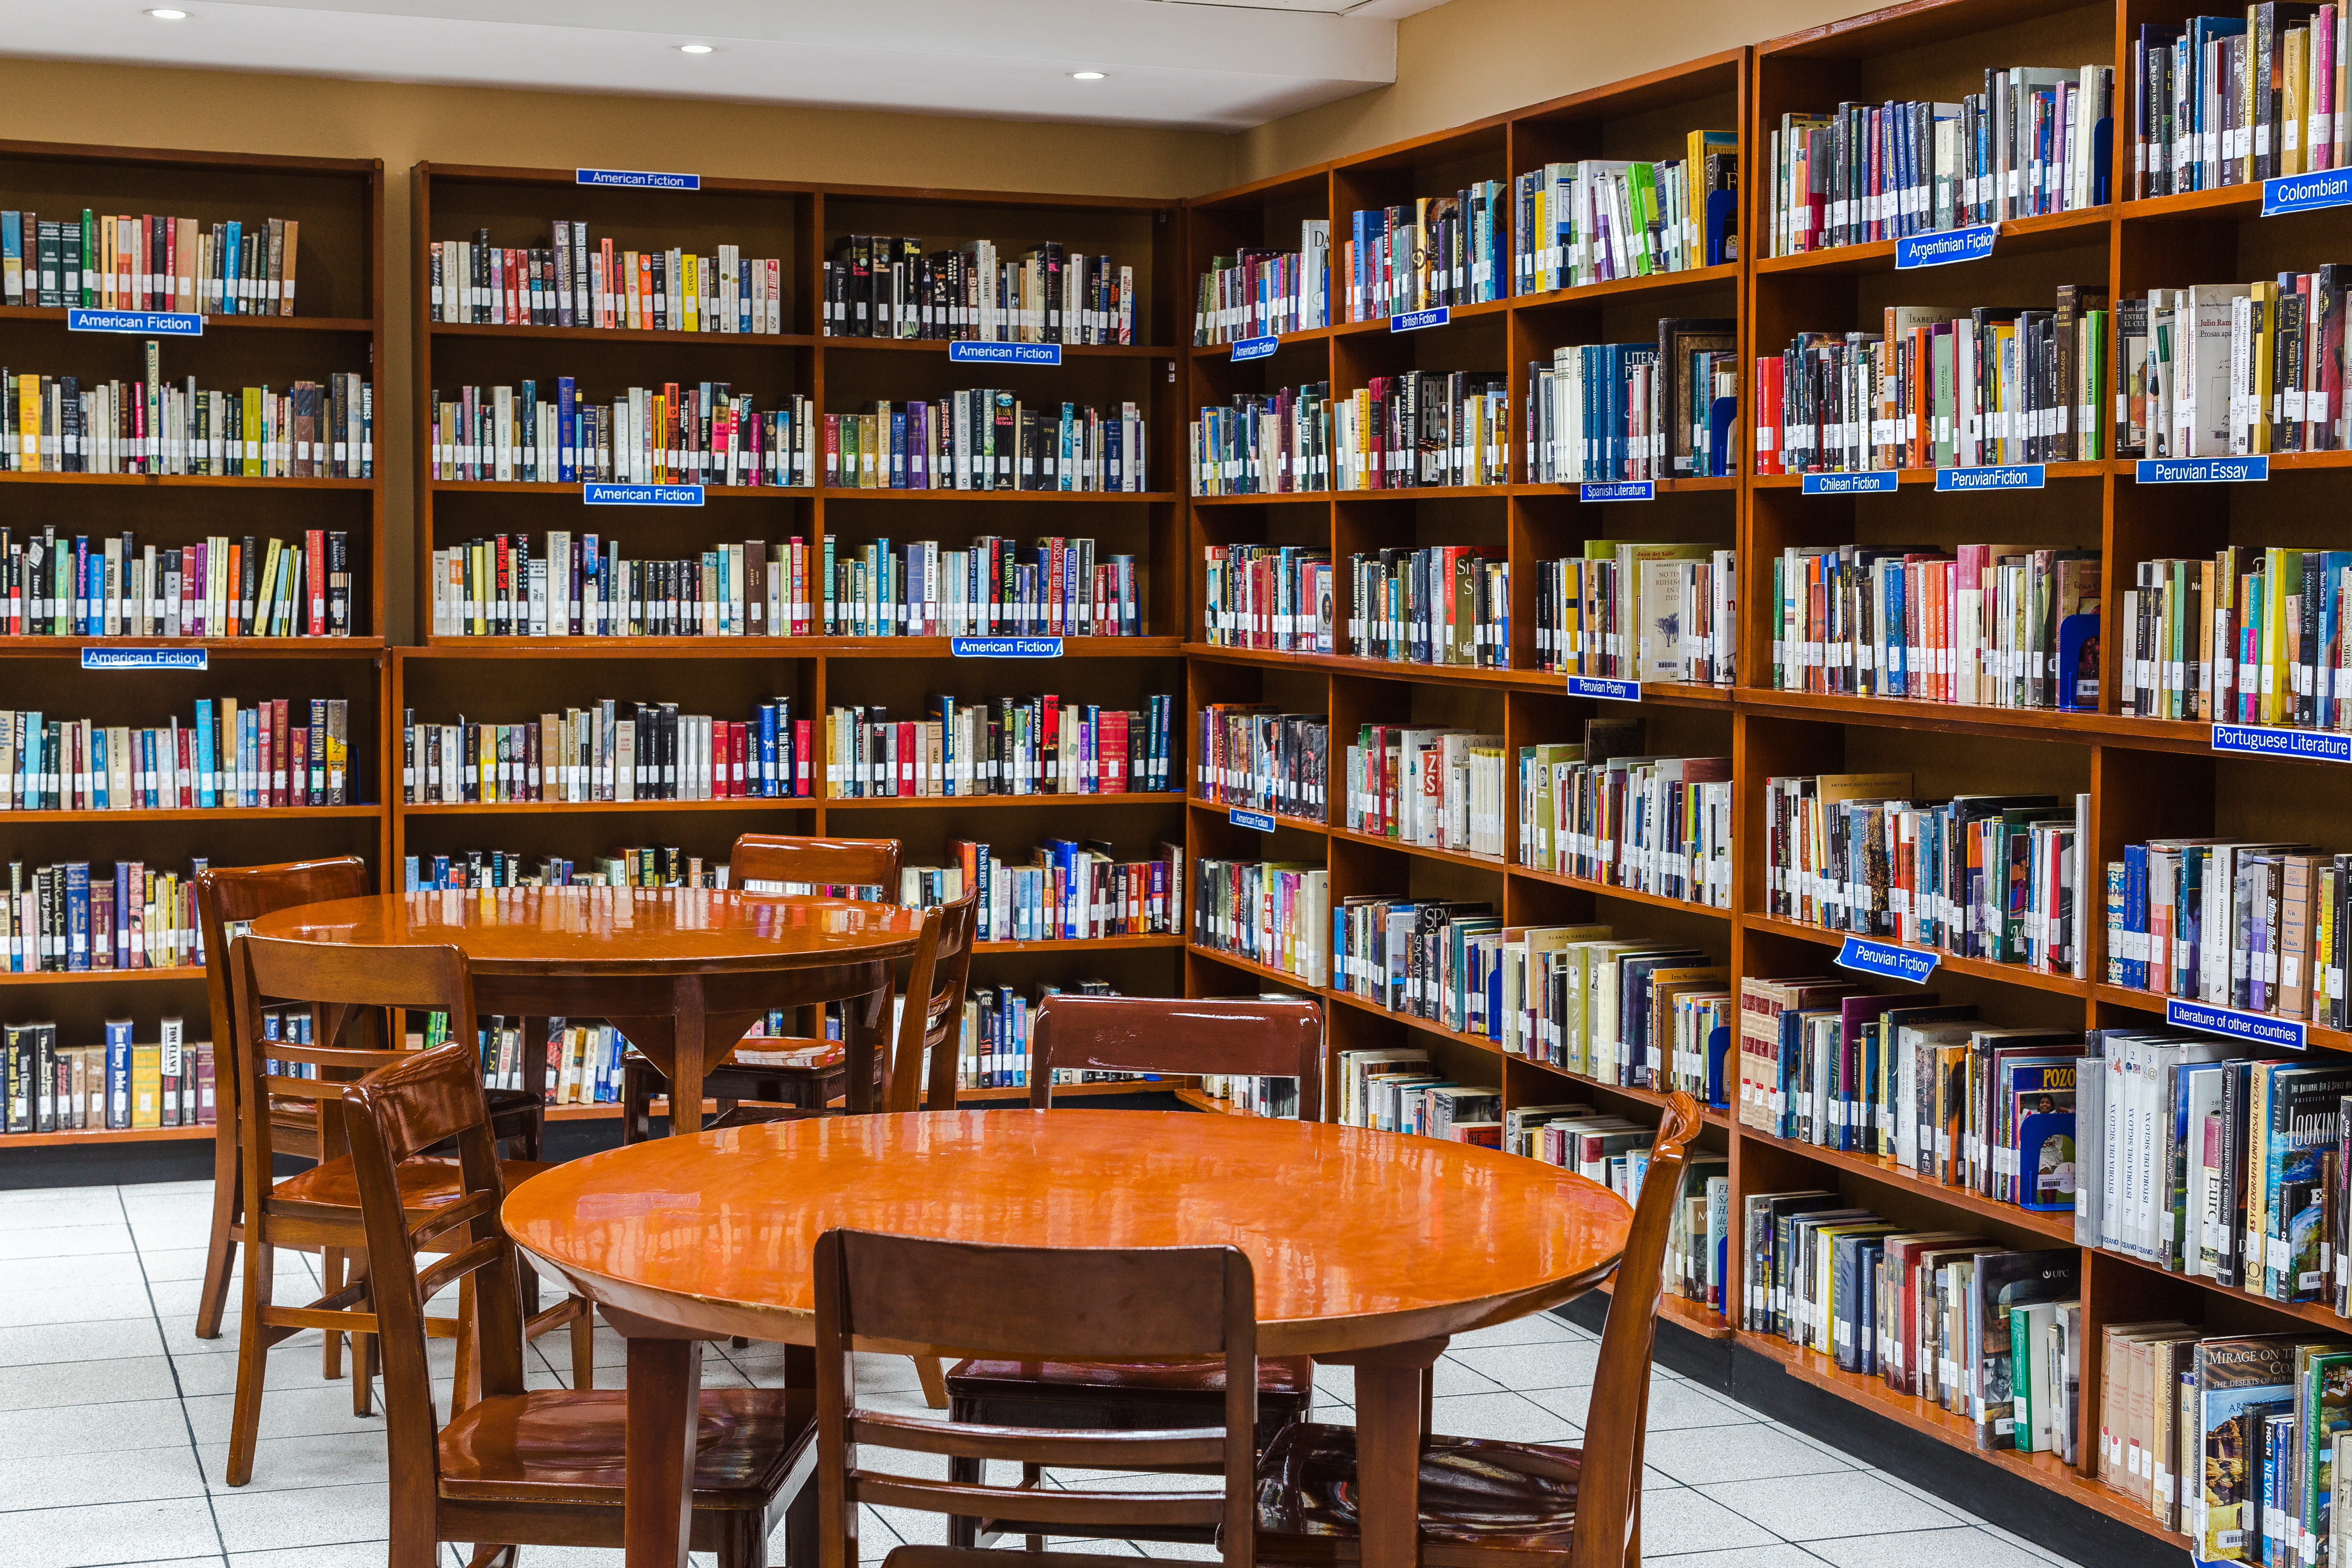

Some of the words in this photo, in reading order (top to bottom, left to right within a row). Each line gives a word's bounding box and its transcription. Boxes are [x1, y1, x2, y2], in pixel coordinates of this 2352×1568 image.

[593, 172, 645, 184] American
[648, 174, 684, 186] Fiction
[2278, 178, 2348, 202] Colombian
[1909, 237, 1964, 260] Argentinian
[78, 314, 143, 328] American
[147, 316, 192, 330] Fiction
[1402, 314, 1418, 327] British
[1419, 312, 1437, 325] Fiction
[1909, 314, 1935, 323] ISABEL
[2200, 319, 2216, 327] Julio
[2220, 330, 2232, 339] apá
[958, 345, 1012, 357] American
[1016, 347, 1052, 359] Fiction
[1236, 346, 1258, 356] American
[1258, 342, 1274, 353] Fiction
[2156, 463, 2207, 480] Peruvian
[2211, 462, 2248, 481] Essay
[1820, 477, 1850, 491] Chilean
[1853, 476, 1880, 490] Fiction
[593, 488, 651, 500] American
[655, 489, 695, 501] Fiction
[1588, 485, 1613, 499] Spanish
[1614, 484, 1646, 496] Literature
[498, 537, 508, 573] VERTICAL
[498, 573, 508, 588] RUN
[960, 641, 1013, 652] American
[1017, 641, 1054, 652] Fiction
[88, 652, 154, 664] American
[156, 652, 200, 665] Fiction
[1580, 679, 1605, 693] Peruvian
[1606, 682, 1626, 697] Poetry
[2217, 728, 2287, 750] Portuguese
[2291, 733, 2348, 755] Literature
[1425, 908, 1451, 929] SPY
[1855, 945, 1896, 967] Peruvian
[1899, 953, 1929, 973] Fiction
[2174, 1006, 2215, 1026] Literature
[2217, 1015, 2226, 1028] of
[2228, 1018, 2252, 1032] other
[2254, 1024, 2296, 1041] countries
[169, 1027, 177, 1043] TOM
[169, 1045, 177, 1075] CLANCY
[2130, 1051, 2135, 1060] 2
[2147, 1055, 2152, 1064] 3
[2043, 1069, 2076, 1087] POZO
[2110, 1104, 2116, 1113] XX
[2129, 1108, 2134, 1118] XX
[2145, 1112, 2151, 1122] XX
[2209, 1350, 2257, 1365] MIRAGE
[2260, 1350, 2280, 1361] ON
[2283, 1348, 2296, 1359] TH
[2230, 1378, 2259, 1387] DESERTS
[2273, 1375, 2295, 1383] PARAC
[2264, 1462, 2273, 1509] NEVAD
